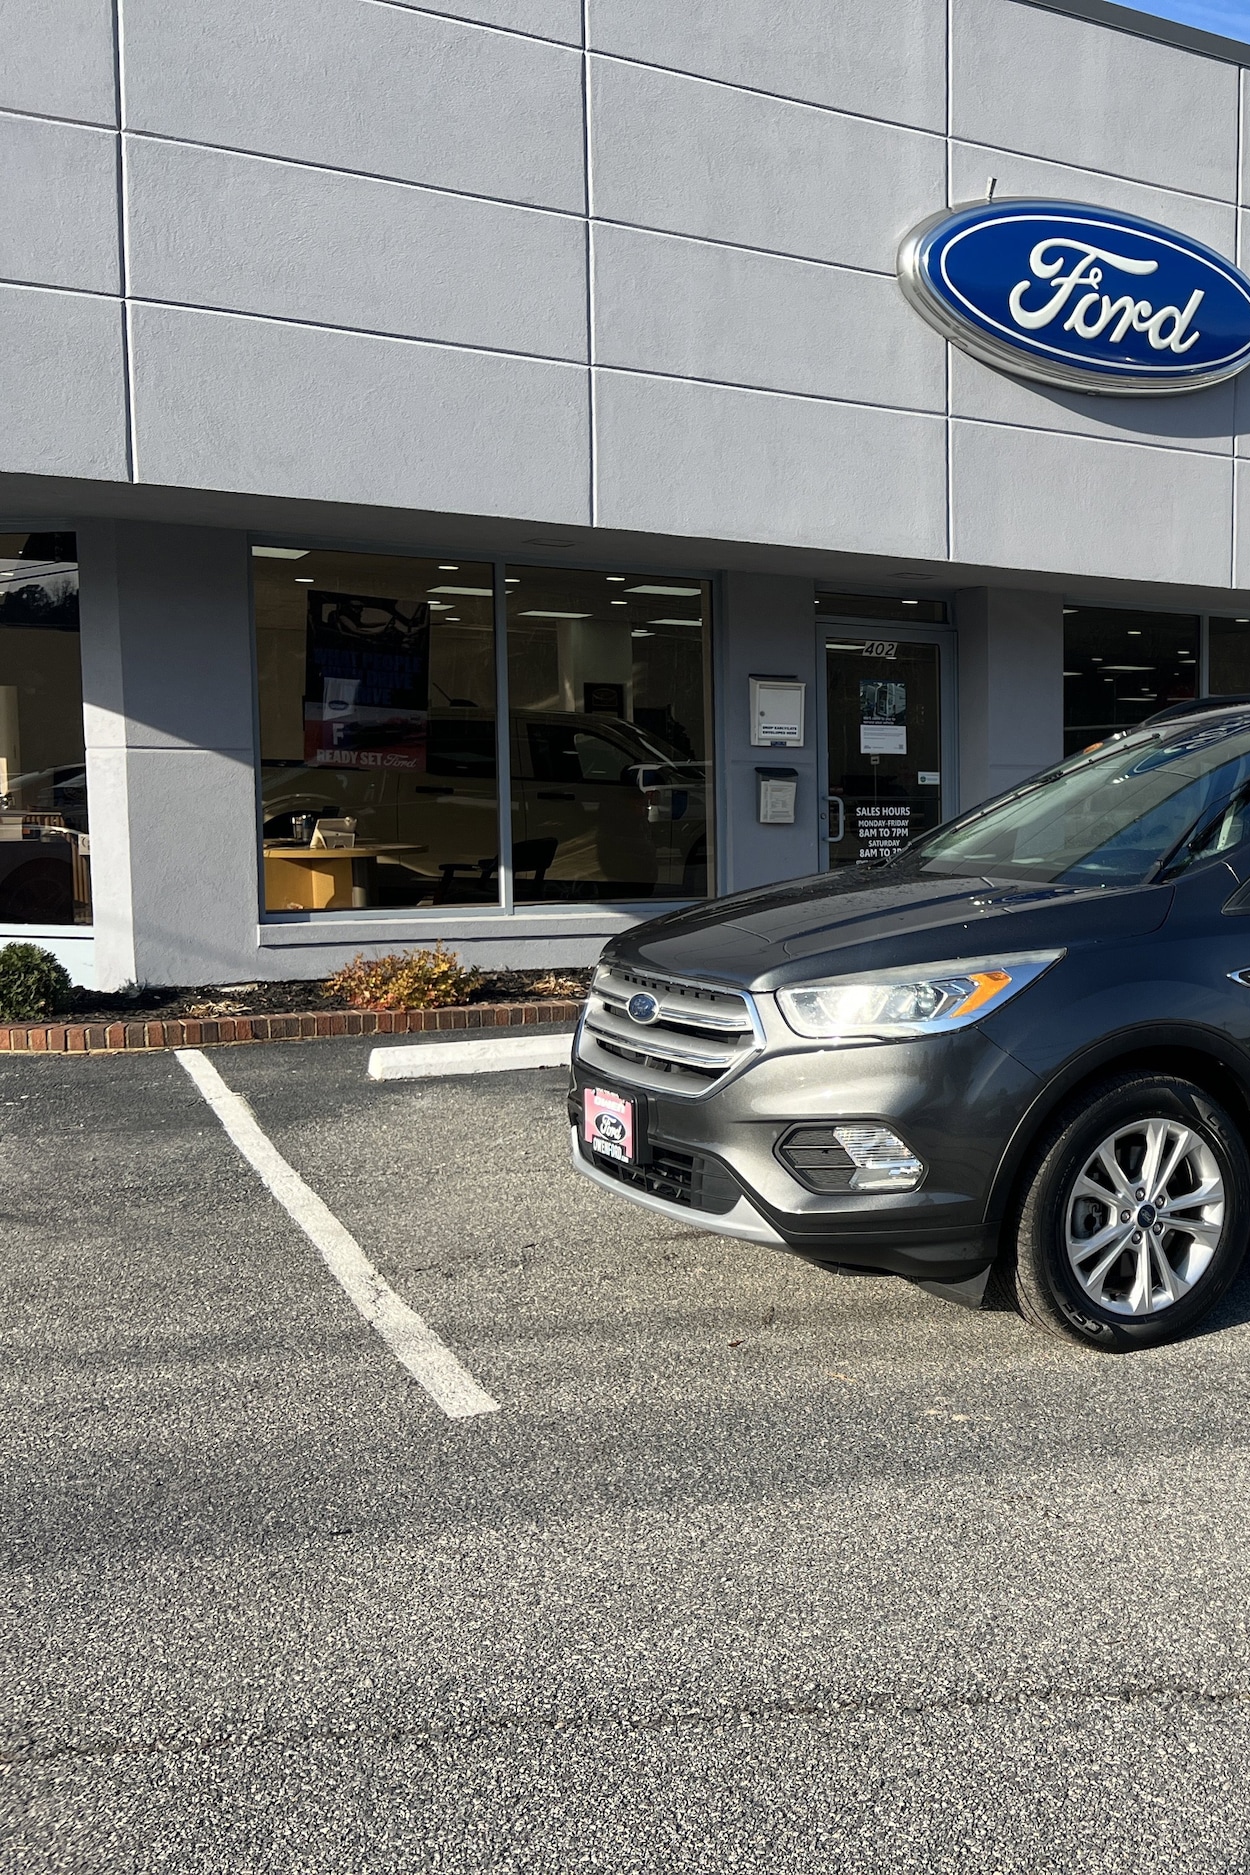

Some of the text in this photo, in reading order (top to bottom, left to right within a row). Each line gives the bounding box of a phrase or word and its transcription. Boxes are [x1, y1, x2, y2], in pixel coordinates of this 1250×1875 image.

[1009, 237, 1205, 354] Ford
[866, 642, 895, 656] 402
[316, 748, 418, 769] READY SET Ford
[856, 807, 911, 816] SALES HOURS
[859, 828, 909, 838] 8AM TO 7PM
[859, 848, 877, 858] 8AM
[879, 848, 891, 857] TO
[600, 1115, 622, 1140] Ford
